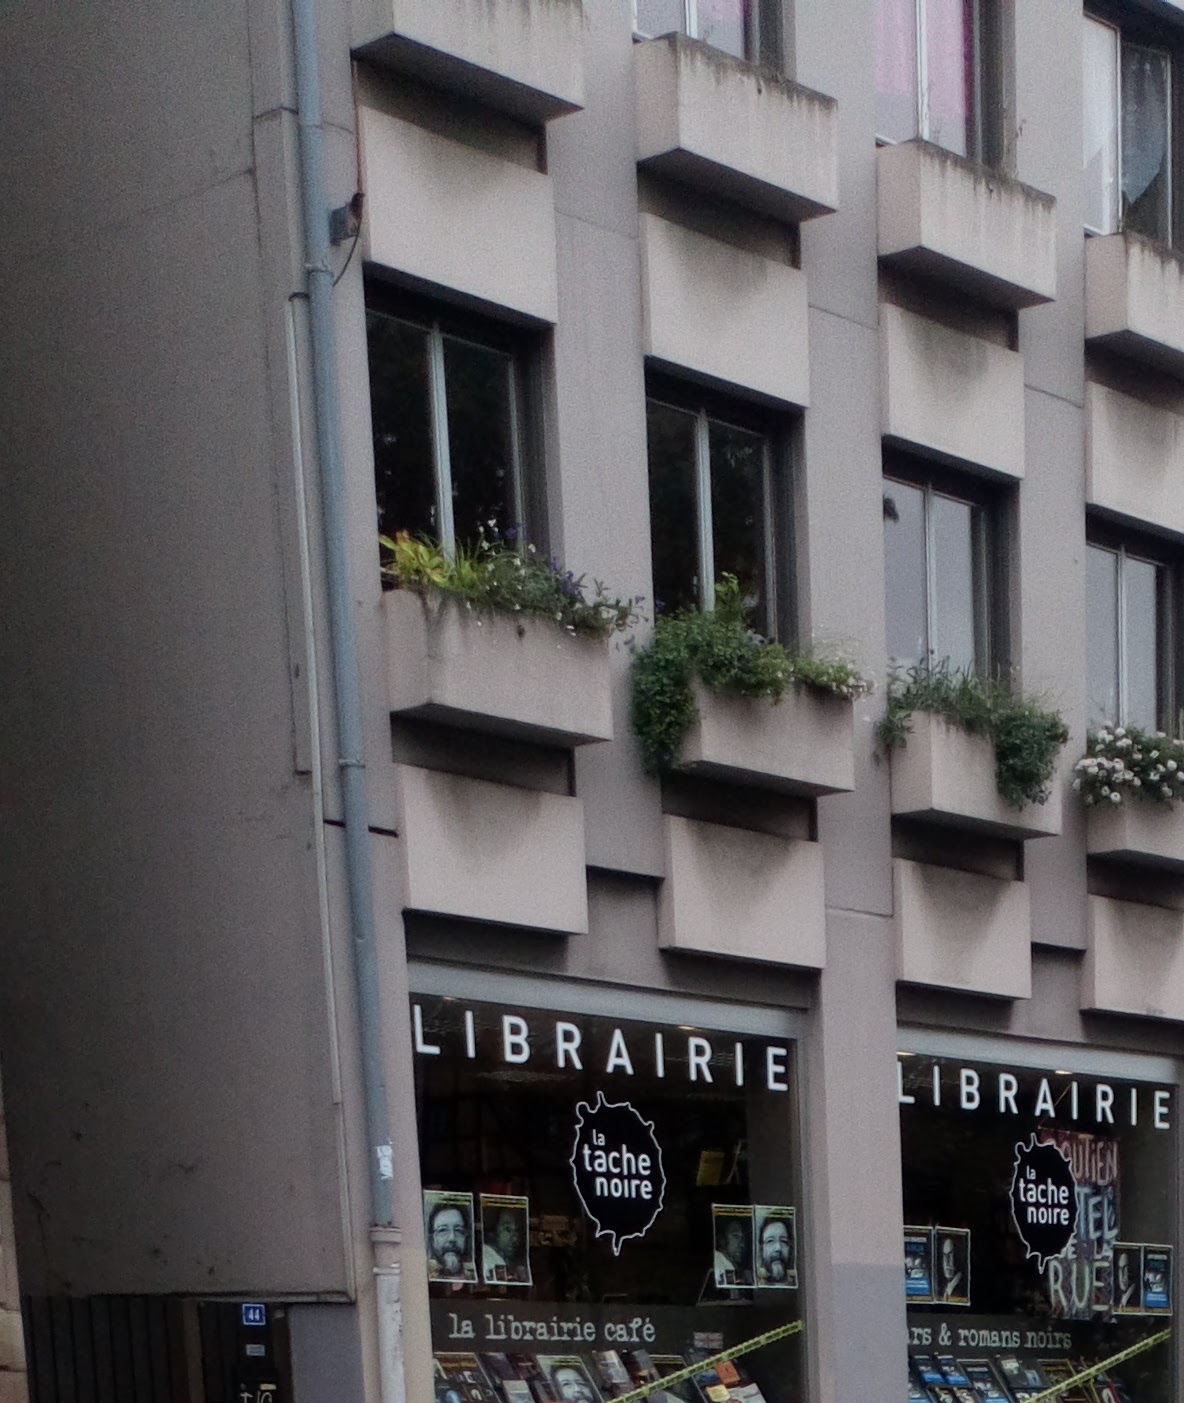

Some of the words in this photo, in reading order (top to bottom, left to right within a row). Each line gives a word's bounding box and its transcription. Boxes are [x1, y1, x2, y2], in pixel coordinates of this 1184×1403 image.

[413, 1004, 788, 1092] LIBRAIRIE
[897, 1061, 1171, 1130] LIBRAIRIE
[592, 1128, 606, 1146] la
[583, 1143, 652, 1176] tache
[1026, 1165, 1037, 1180] la
[595, 1176, 654, 1200] noire
[1018, 1178, 1070, 1205] tache
[1026, 1206, 1071, 1226] noire
[248, 1307, 261, 1321] 44
[448, 1312, 475, 1339] la
[484, 1313, 596, 1342] librairie
[604, 1316, 656, 1343] café
[938, 1322, 953, 1346] &
[957, 1327, 1021, 1348] romans
[1023, 1326, 1073, 1350] noirs
